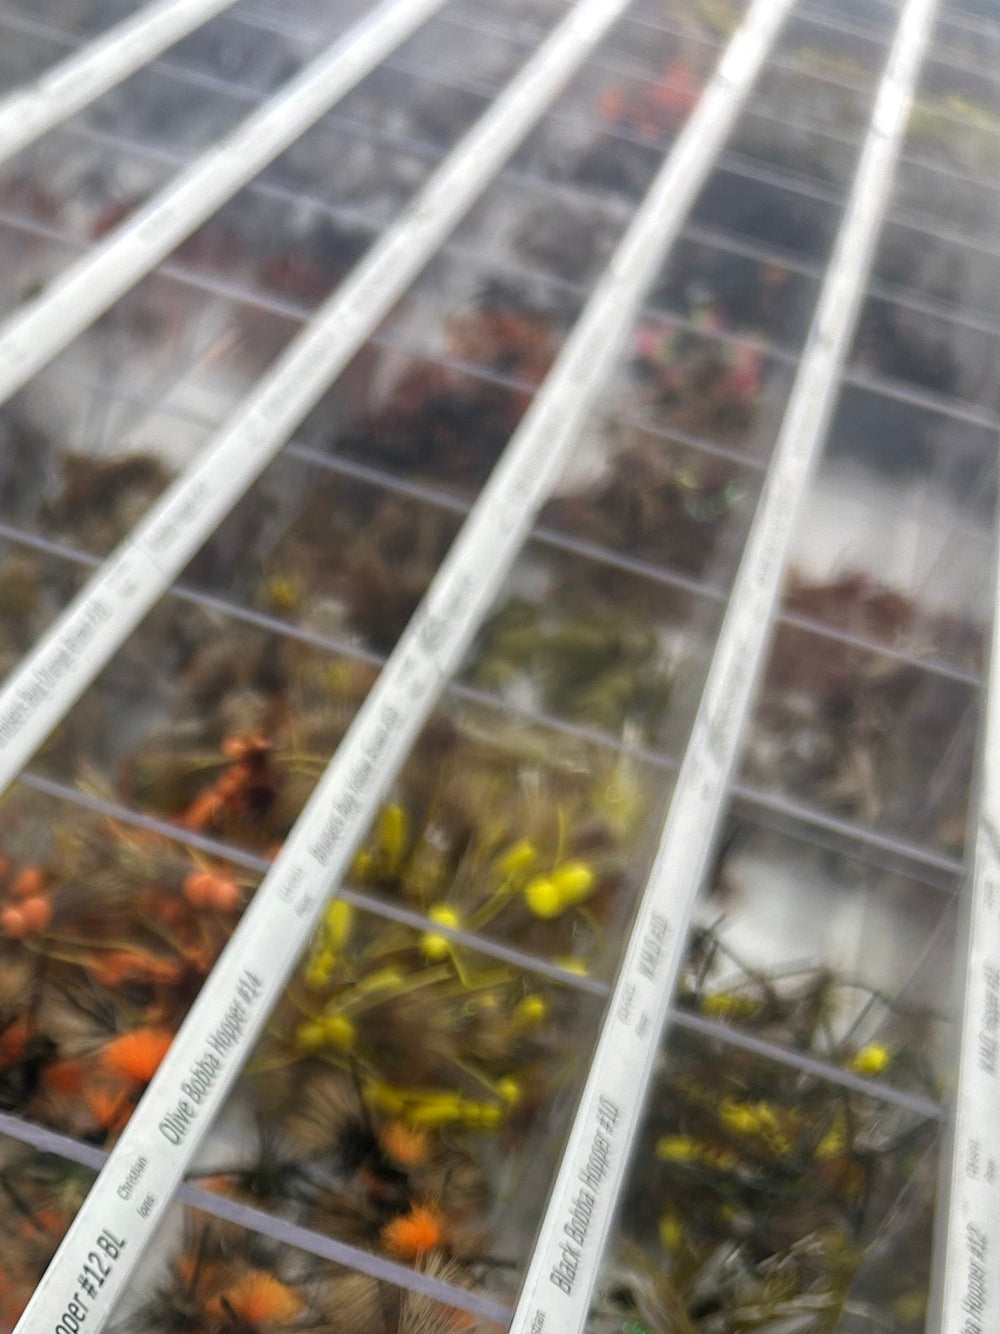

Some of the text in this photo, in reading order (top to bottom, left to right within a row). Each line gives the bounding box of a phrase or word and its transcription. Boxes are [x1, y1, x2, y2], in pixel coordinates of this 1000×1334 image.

[158, 970, 264, 1147] Olive Bobba Hopper #14
[116, 1155, 149, 1201] Christian
[549, 1093, 622, 1297] Black Bobba Hopper #10
[78, 1252, 113, 1300] #12
[96, 1229, 126, 1261] BL
